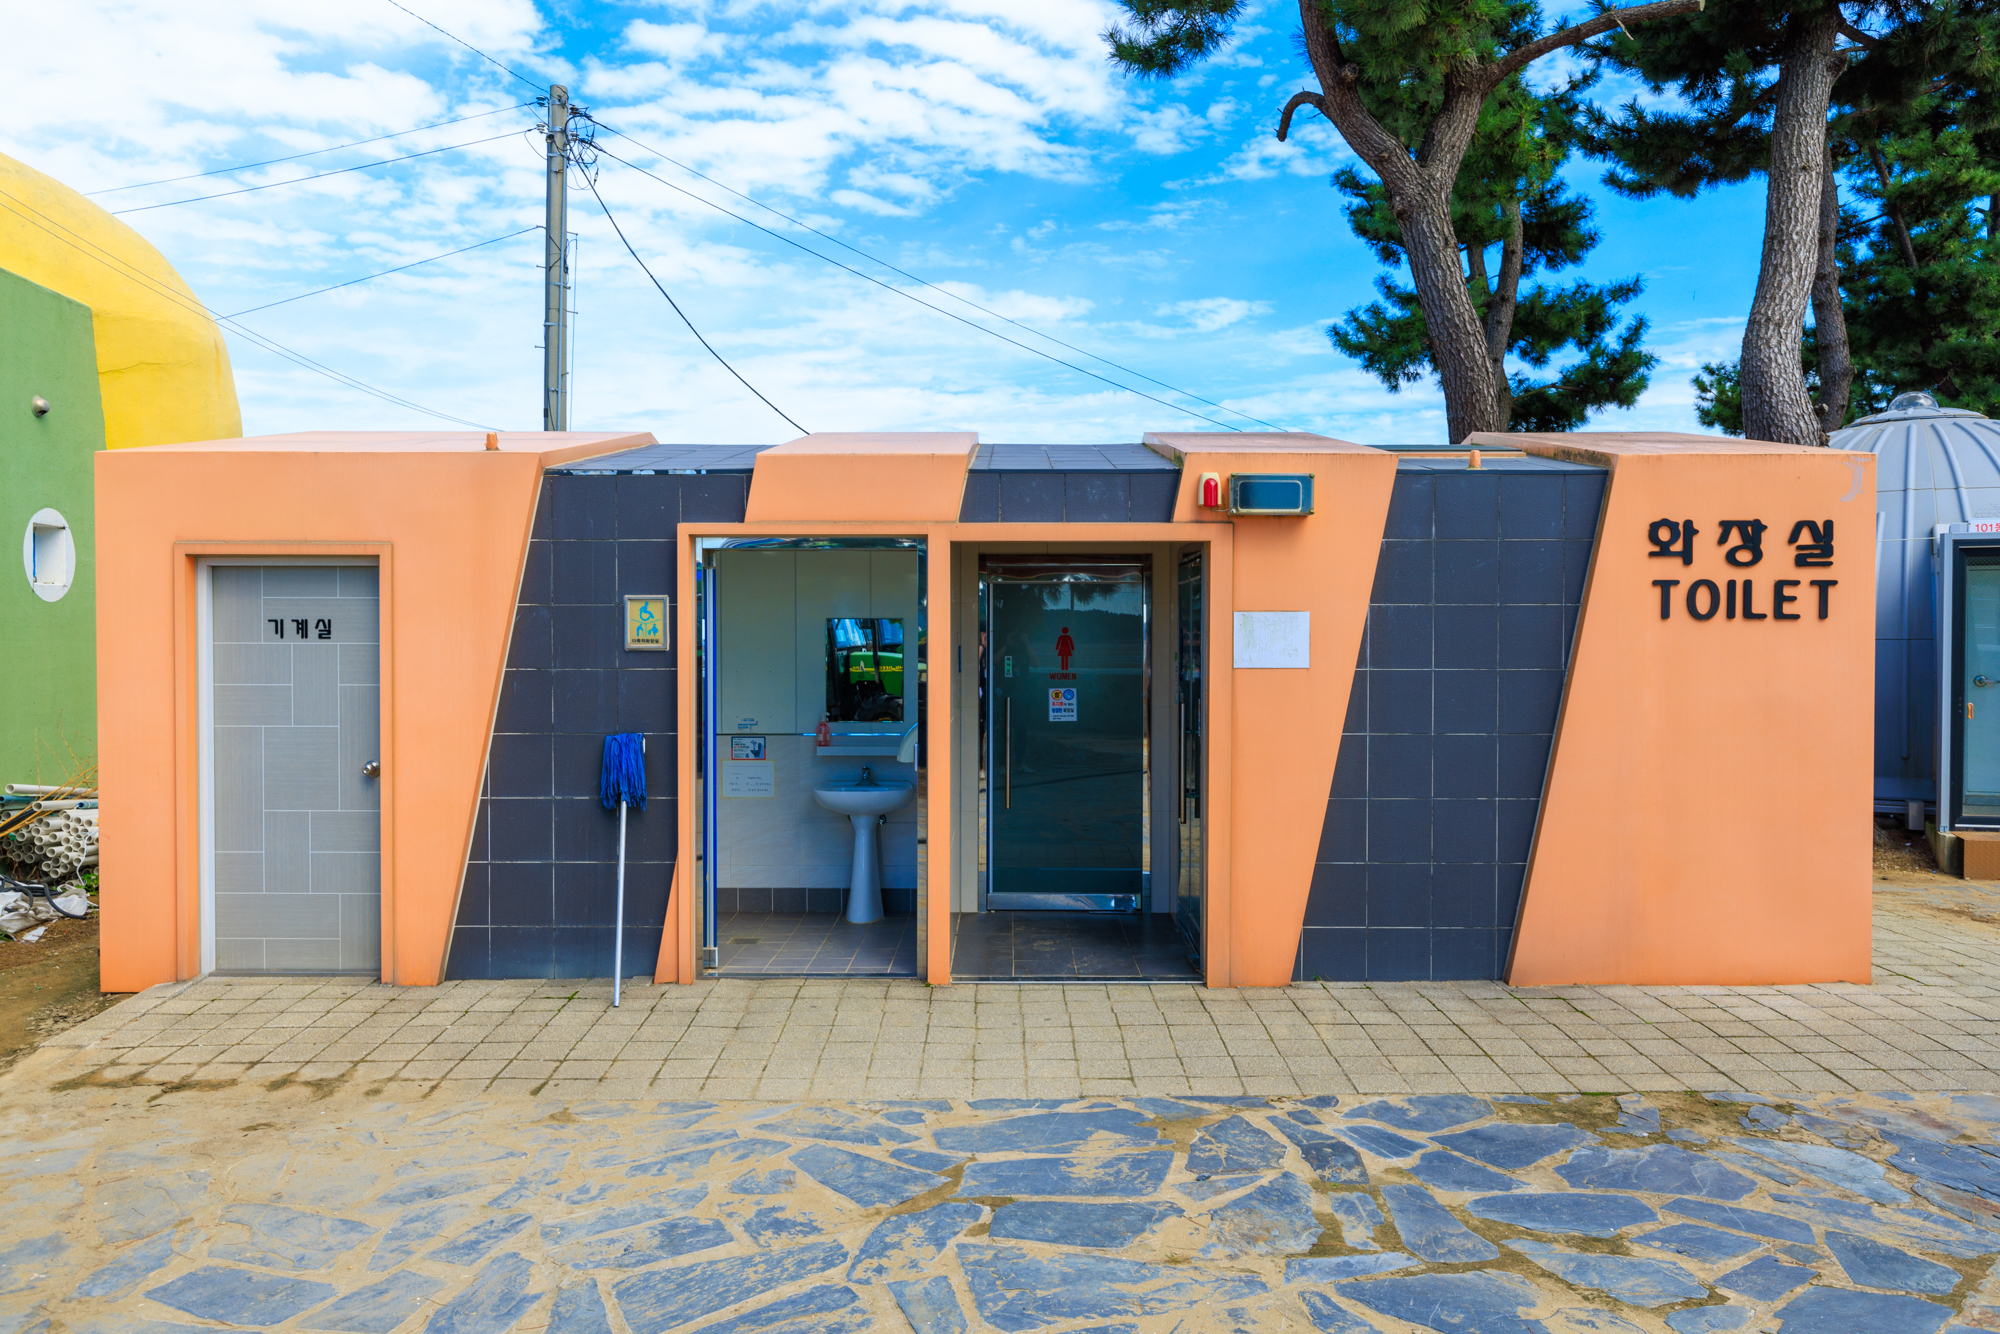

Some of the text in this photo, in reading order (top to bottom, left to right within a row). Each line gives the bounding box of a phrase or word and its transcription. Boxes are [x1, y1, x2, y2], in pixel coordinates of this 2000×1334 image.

[1648, 518, 1835, 567] 화장실
[1652, 579, 1838, 620] TOILET
[267, 618, 332, 639] 기계실
[1049, 672, 1077, 680] WOMEN
